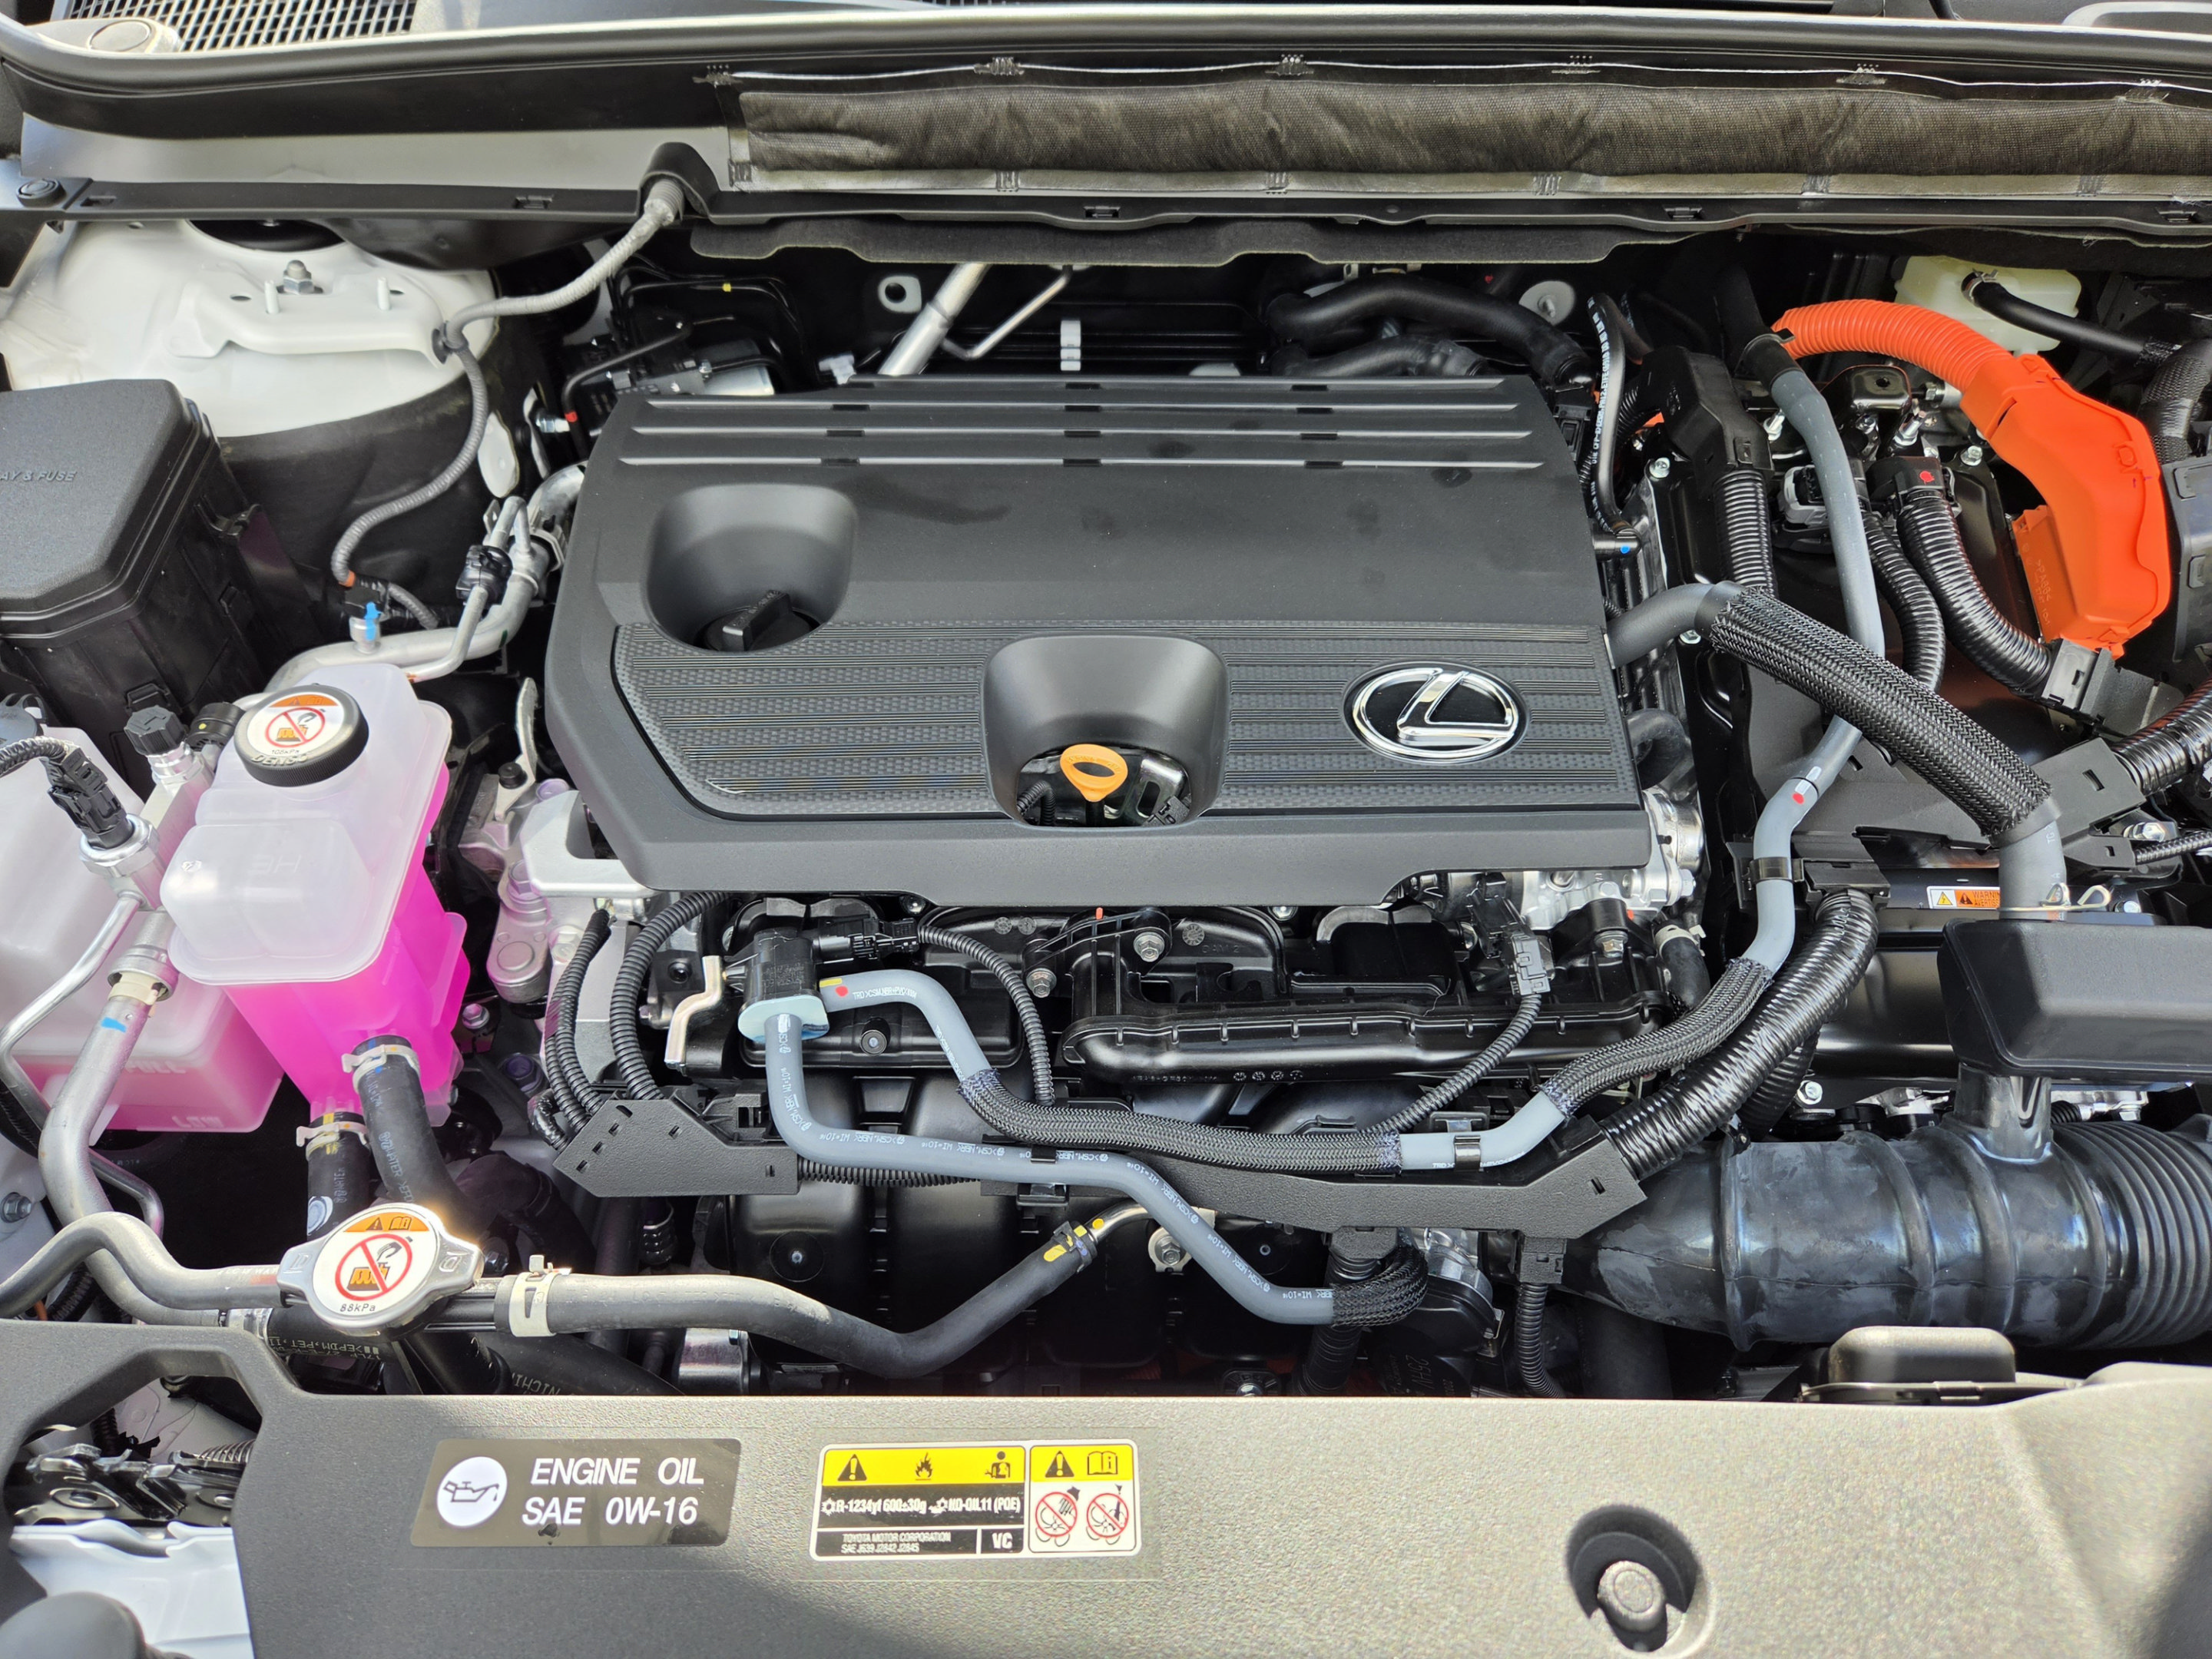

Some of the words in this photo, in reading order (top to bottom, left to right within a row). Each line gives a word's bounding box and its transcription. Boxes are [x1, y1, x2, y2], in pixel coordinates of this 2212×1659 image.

[23, 470, 34, 482] &
[38, 470, 77, 482] FUSE
[250, 753, 307, 766] DENSO
[386, 1147, 402, 1177] WATER
[339, 1303, 376, 1313] 88kPa
[269, 1335, 363, 1352] >EPDM,PET,II
[530, 1457, 641, 1485] ENGINE
[657, 1457, 704, 1485] OIL
[522, 1496, 585, 1525] SAE
[605, 1496, 698, 1525] 0W-16
[836, 1498, 882, 1515] R-1234yf
[993, 1496, 1021, 1514] (POE)
[842, 1532, 871, 1543] TOYOTA
[872, 1532, 898, 1542] MOTOR
[899, 1532, 951, 1542] CORPORATION
[992, 1532, 1013, 1549] VC
[840, 1543, 856, 1554] SAE
[856, 1542, 875, 1553] J639
